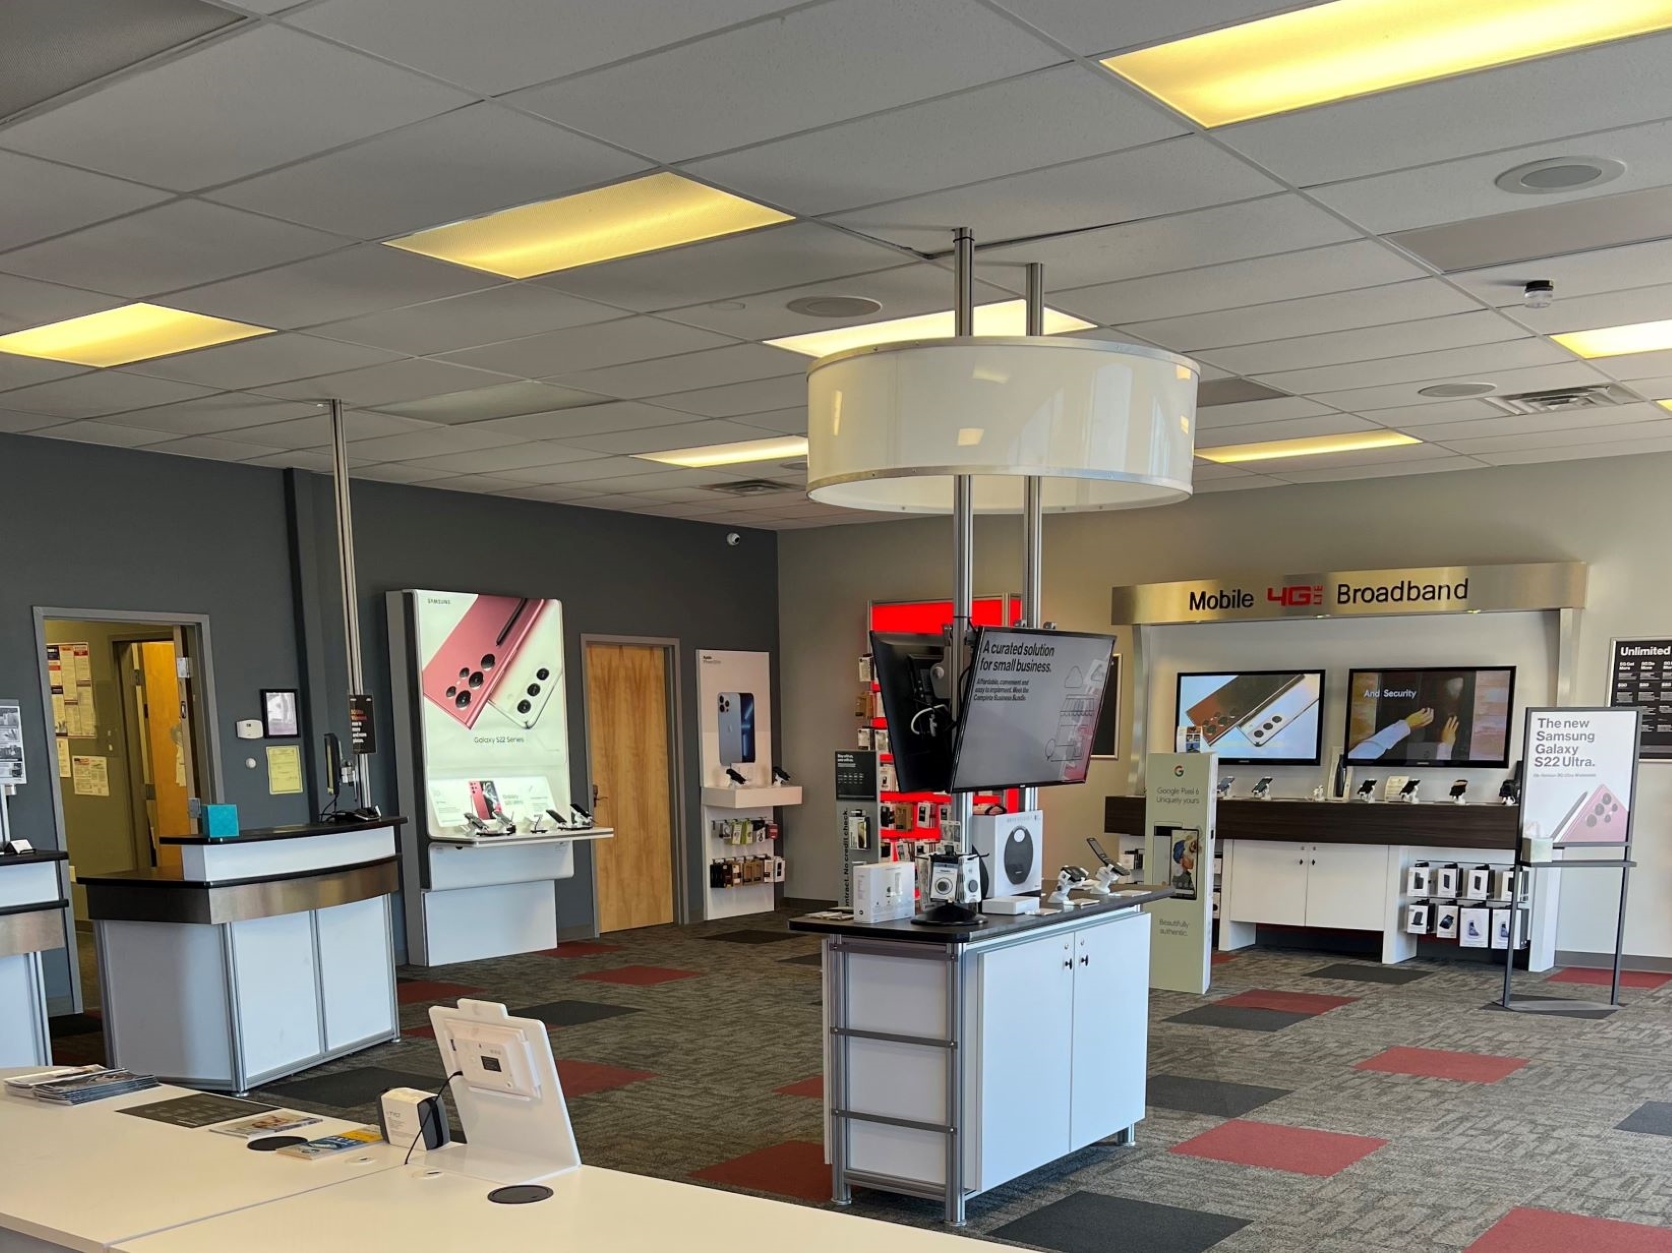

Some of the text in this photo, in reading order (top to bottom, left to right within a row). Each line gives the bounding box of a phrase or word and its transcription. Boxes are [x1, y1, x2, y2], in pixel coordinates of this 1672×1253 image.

[1189, 578, 1469, 610] Mobile 4G LTE Broadband
[983, 640, 1055, 656] A curated solution
[1620, 646, 1671, 656] Unlimited
[980, 657, 1052, 672] for small business.
[1364, 689, 1417, 699] And Security
[1537, 717, 1590, 728] The new
[474, 736, 495, 744] Galaxy
[1536, 730, 1595, 743] Samsung
[1535, 743, 1579, 755] Galaxy
[1534, 756, 1596, 767] S22 Ultra.
[1156, 786, 1180, 796] Google
[1181, 787, 1194, 795] Pixel
[1156, 796, 1181, 805] Uniquely
[844, 863, 849, 875] No
[1159, 918, 1189, 928] Beautifully
